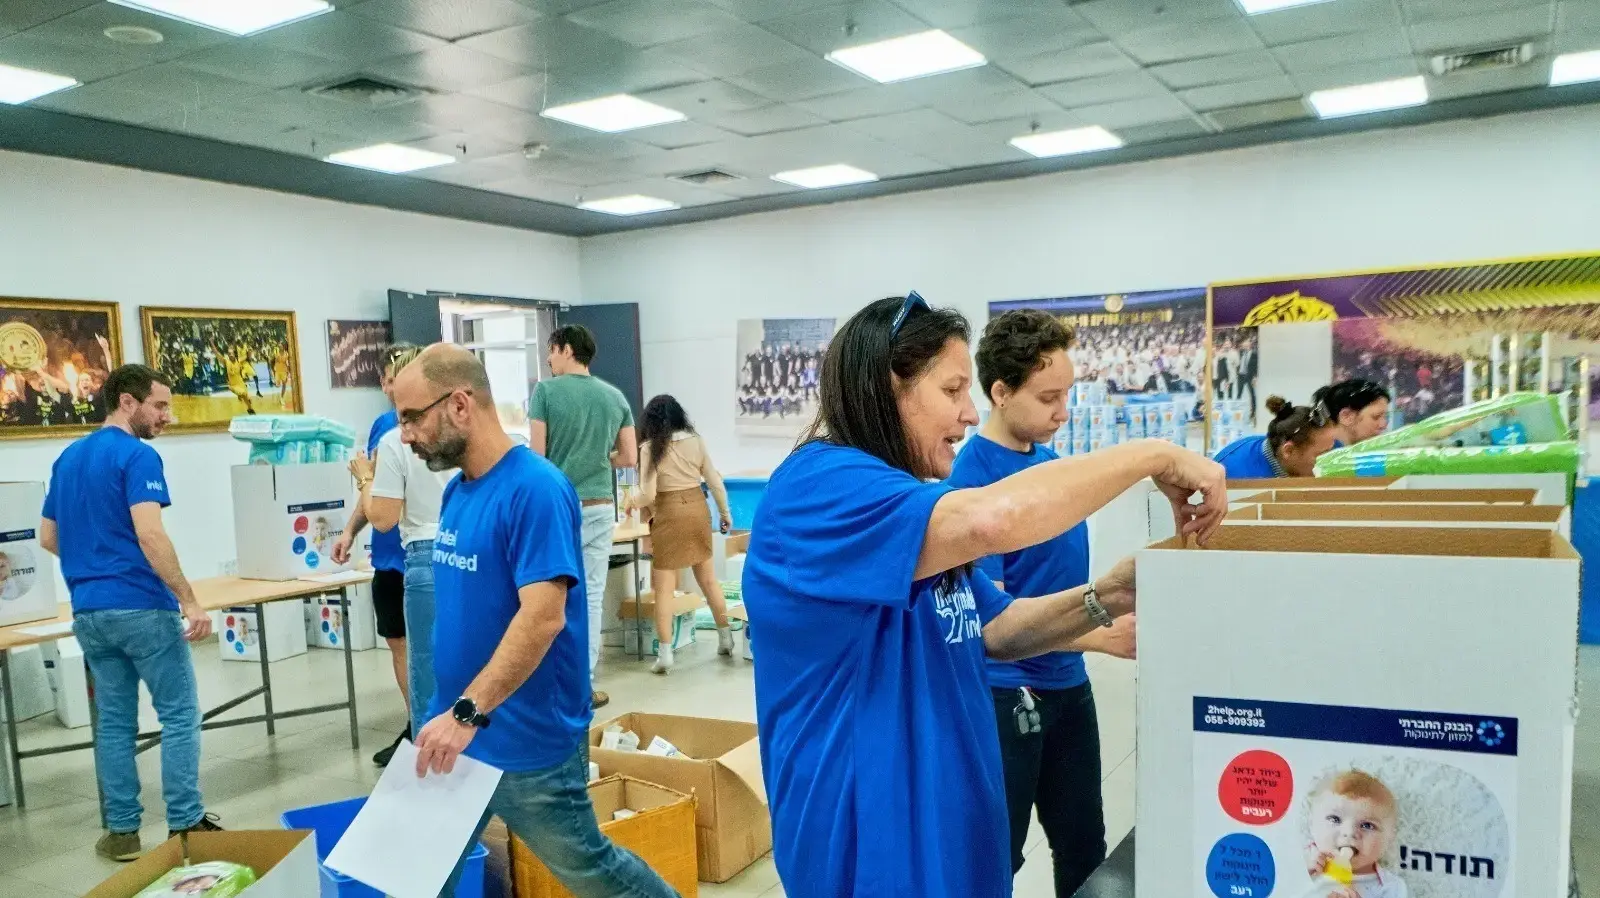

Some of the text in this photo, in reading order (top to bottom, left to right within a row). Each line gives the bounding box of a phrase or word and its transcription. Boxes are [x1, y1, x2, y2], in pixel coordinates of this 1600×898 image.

[1207, 704, 1263, 718] 2help.org.il
[1204, 715, 1266, 728] 055-909392
[1398, 718, 1474, 732] הבנק החברתי
[1403, 728, 1473, 742] למזון לתינוקות
[1241, 806, 1273, 818] רעבים
[1400, 845, 1494, 879] תודה!
